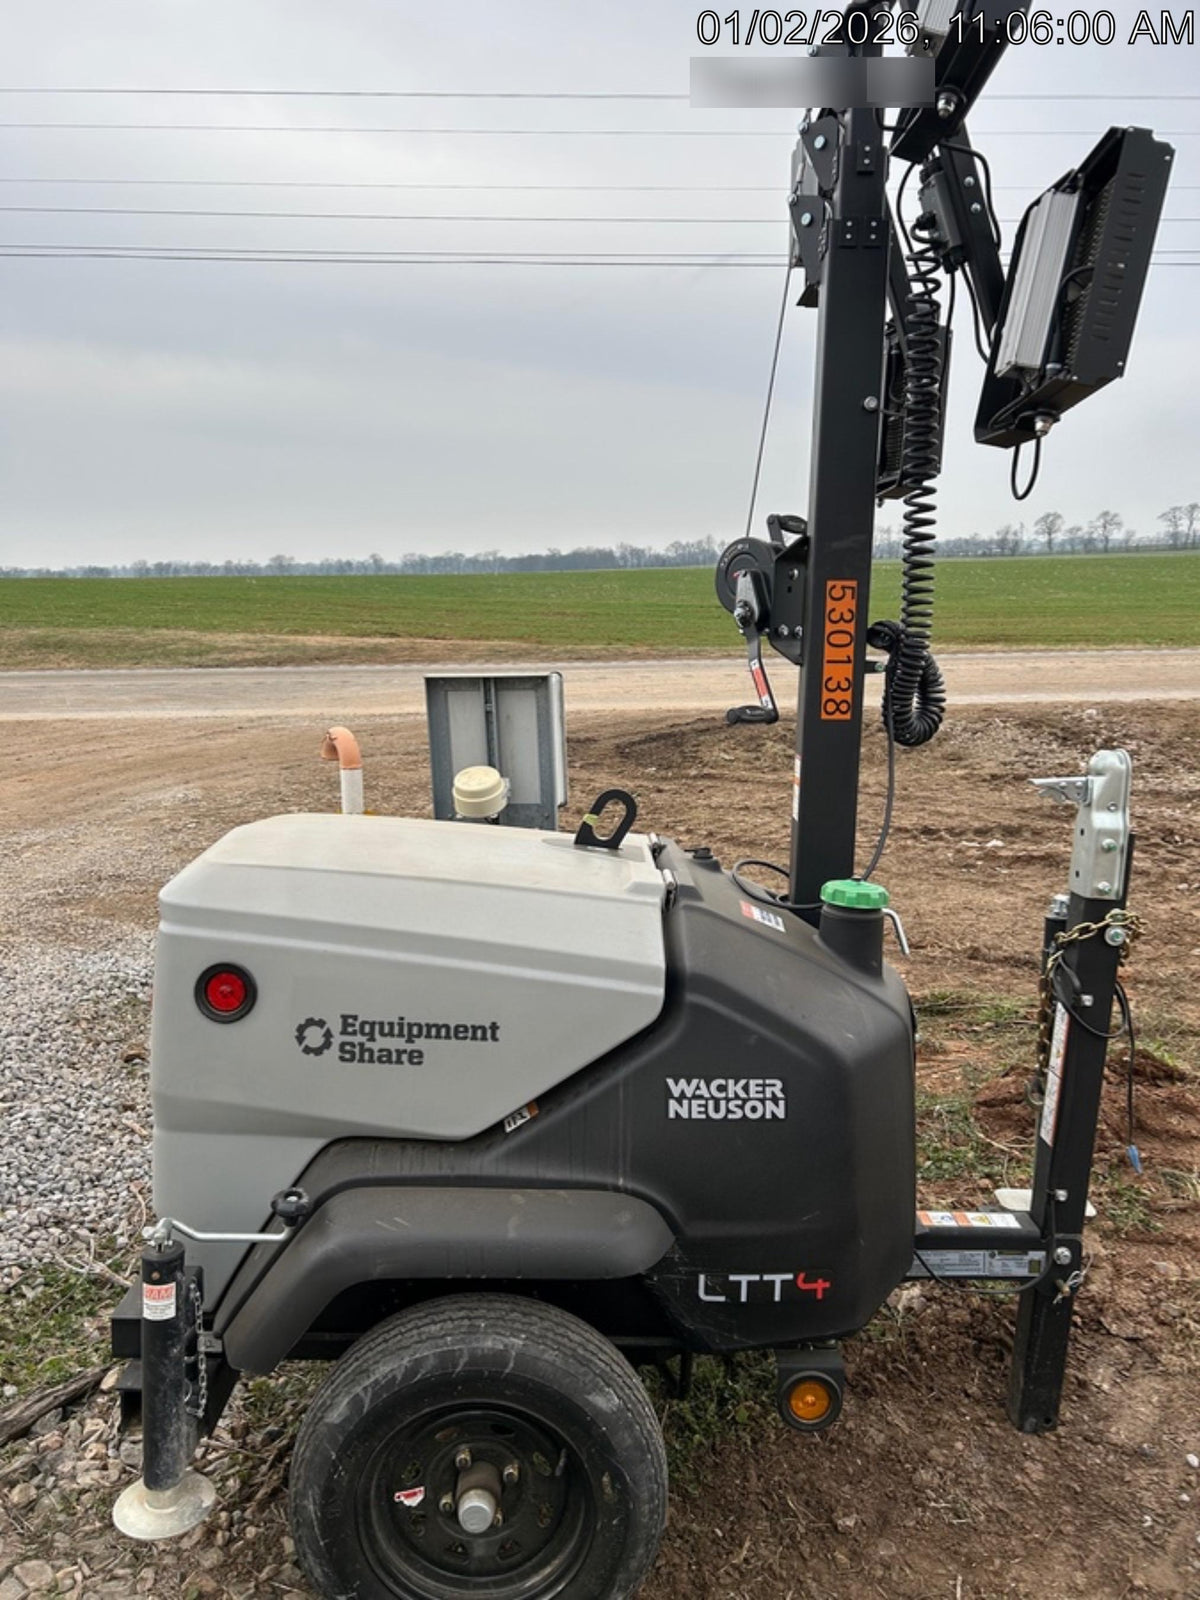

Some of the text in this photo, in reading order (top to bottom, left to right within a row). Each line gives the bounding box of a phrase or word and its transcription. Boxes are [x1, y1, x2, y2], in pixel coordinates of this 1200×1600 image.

[823, 584, 855, 716] 530138
[338, 1014, 501, 1044] Equipment
[337, 1041, 424, 1066] Share
[665, 1077, 786, 1099] WACKER
[667, 1098, 786, 1120] NEUSON
[698, 1272, 831, 1302] LTT4
